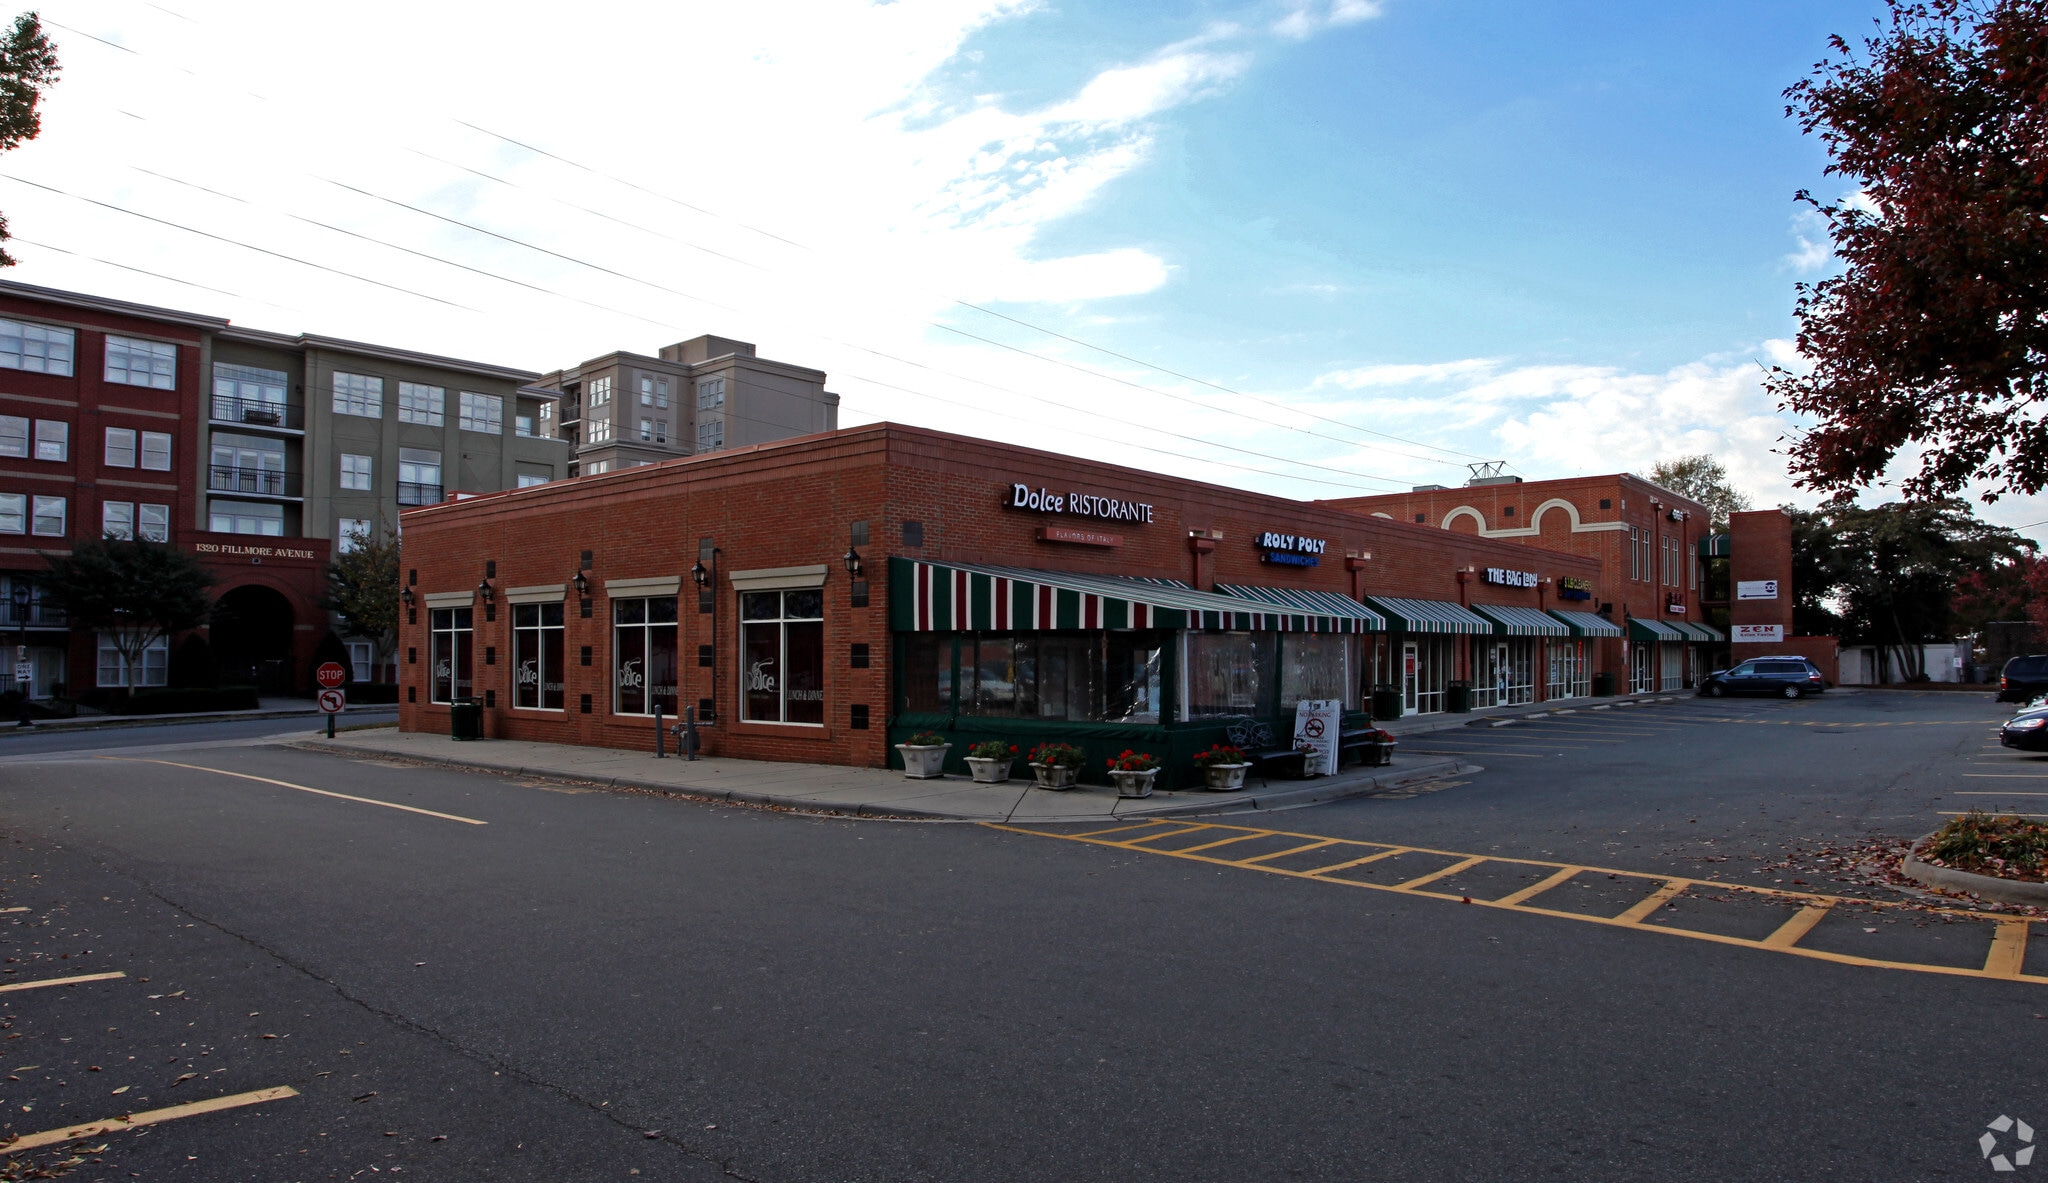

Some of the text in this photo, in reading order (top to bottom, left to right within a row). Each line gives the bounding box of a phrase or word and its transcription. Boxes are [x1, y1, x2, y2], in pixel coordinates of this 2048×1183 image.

[1013, 483, 1154, 523] Dolce RISTORANTE
[1056, 530, 1085, 541] FLAVORS
[1097, 535, 1115, 543] ITALY
[1263, 532, 1326, 554] ROLY POLY
[195, 543, 314, 559] 1320 FILLMORE AVENUE
[1270, 552, 1320, 567] SANDWICHES
[1487, 568, 1505, 584] THE
[1506, 569, 1522, 586] BAG
[1740, 625, 1774, 633] ZEN
[319, 670, 343, 680] STOP
